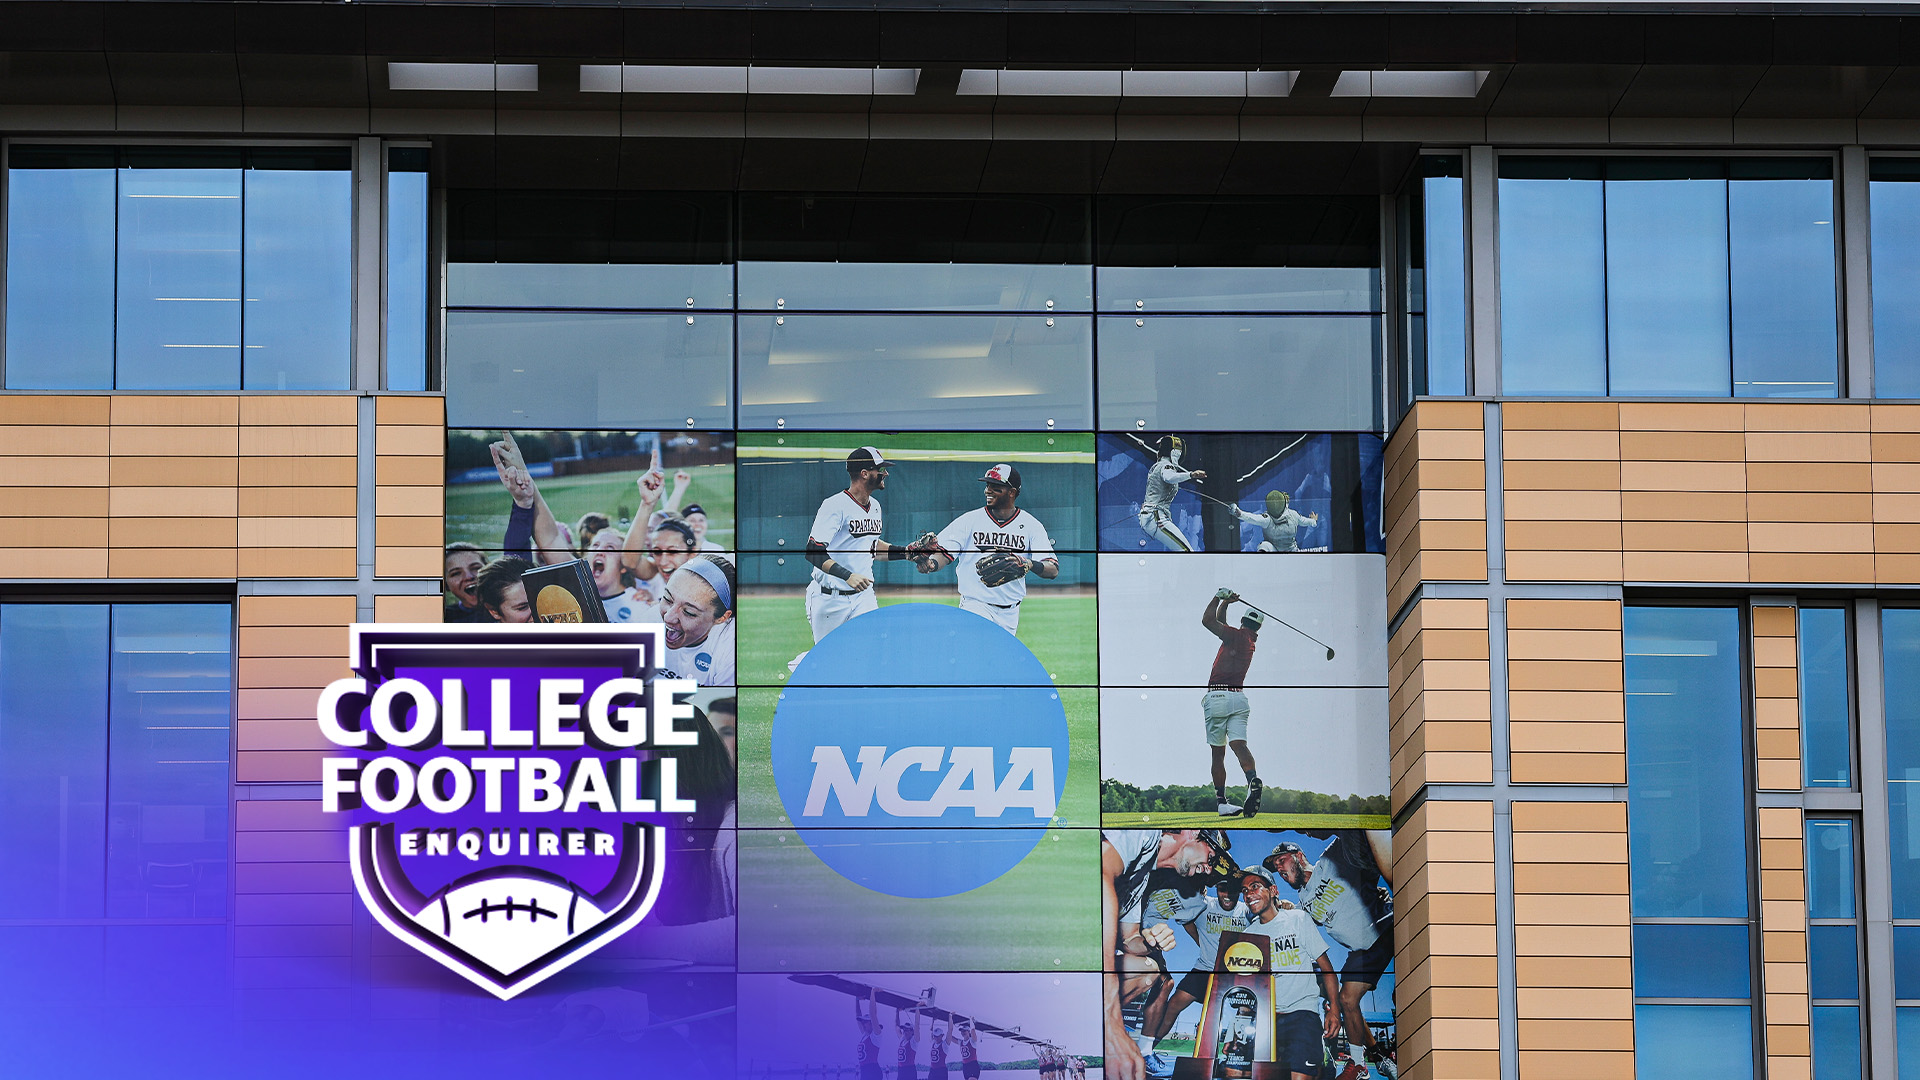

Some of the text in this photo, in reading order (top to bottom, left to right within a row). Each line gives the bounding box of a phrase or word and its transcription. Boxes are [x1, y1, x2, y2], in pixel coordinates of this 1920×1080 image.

[973, 531, 1026, 550] SPARTANS
[802, 745, 1056, 818] NCAA
[1227, 956, 1262, 968] NCAA
